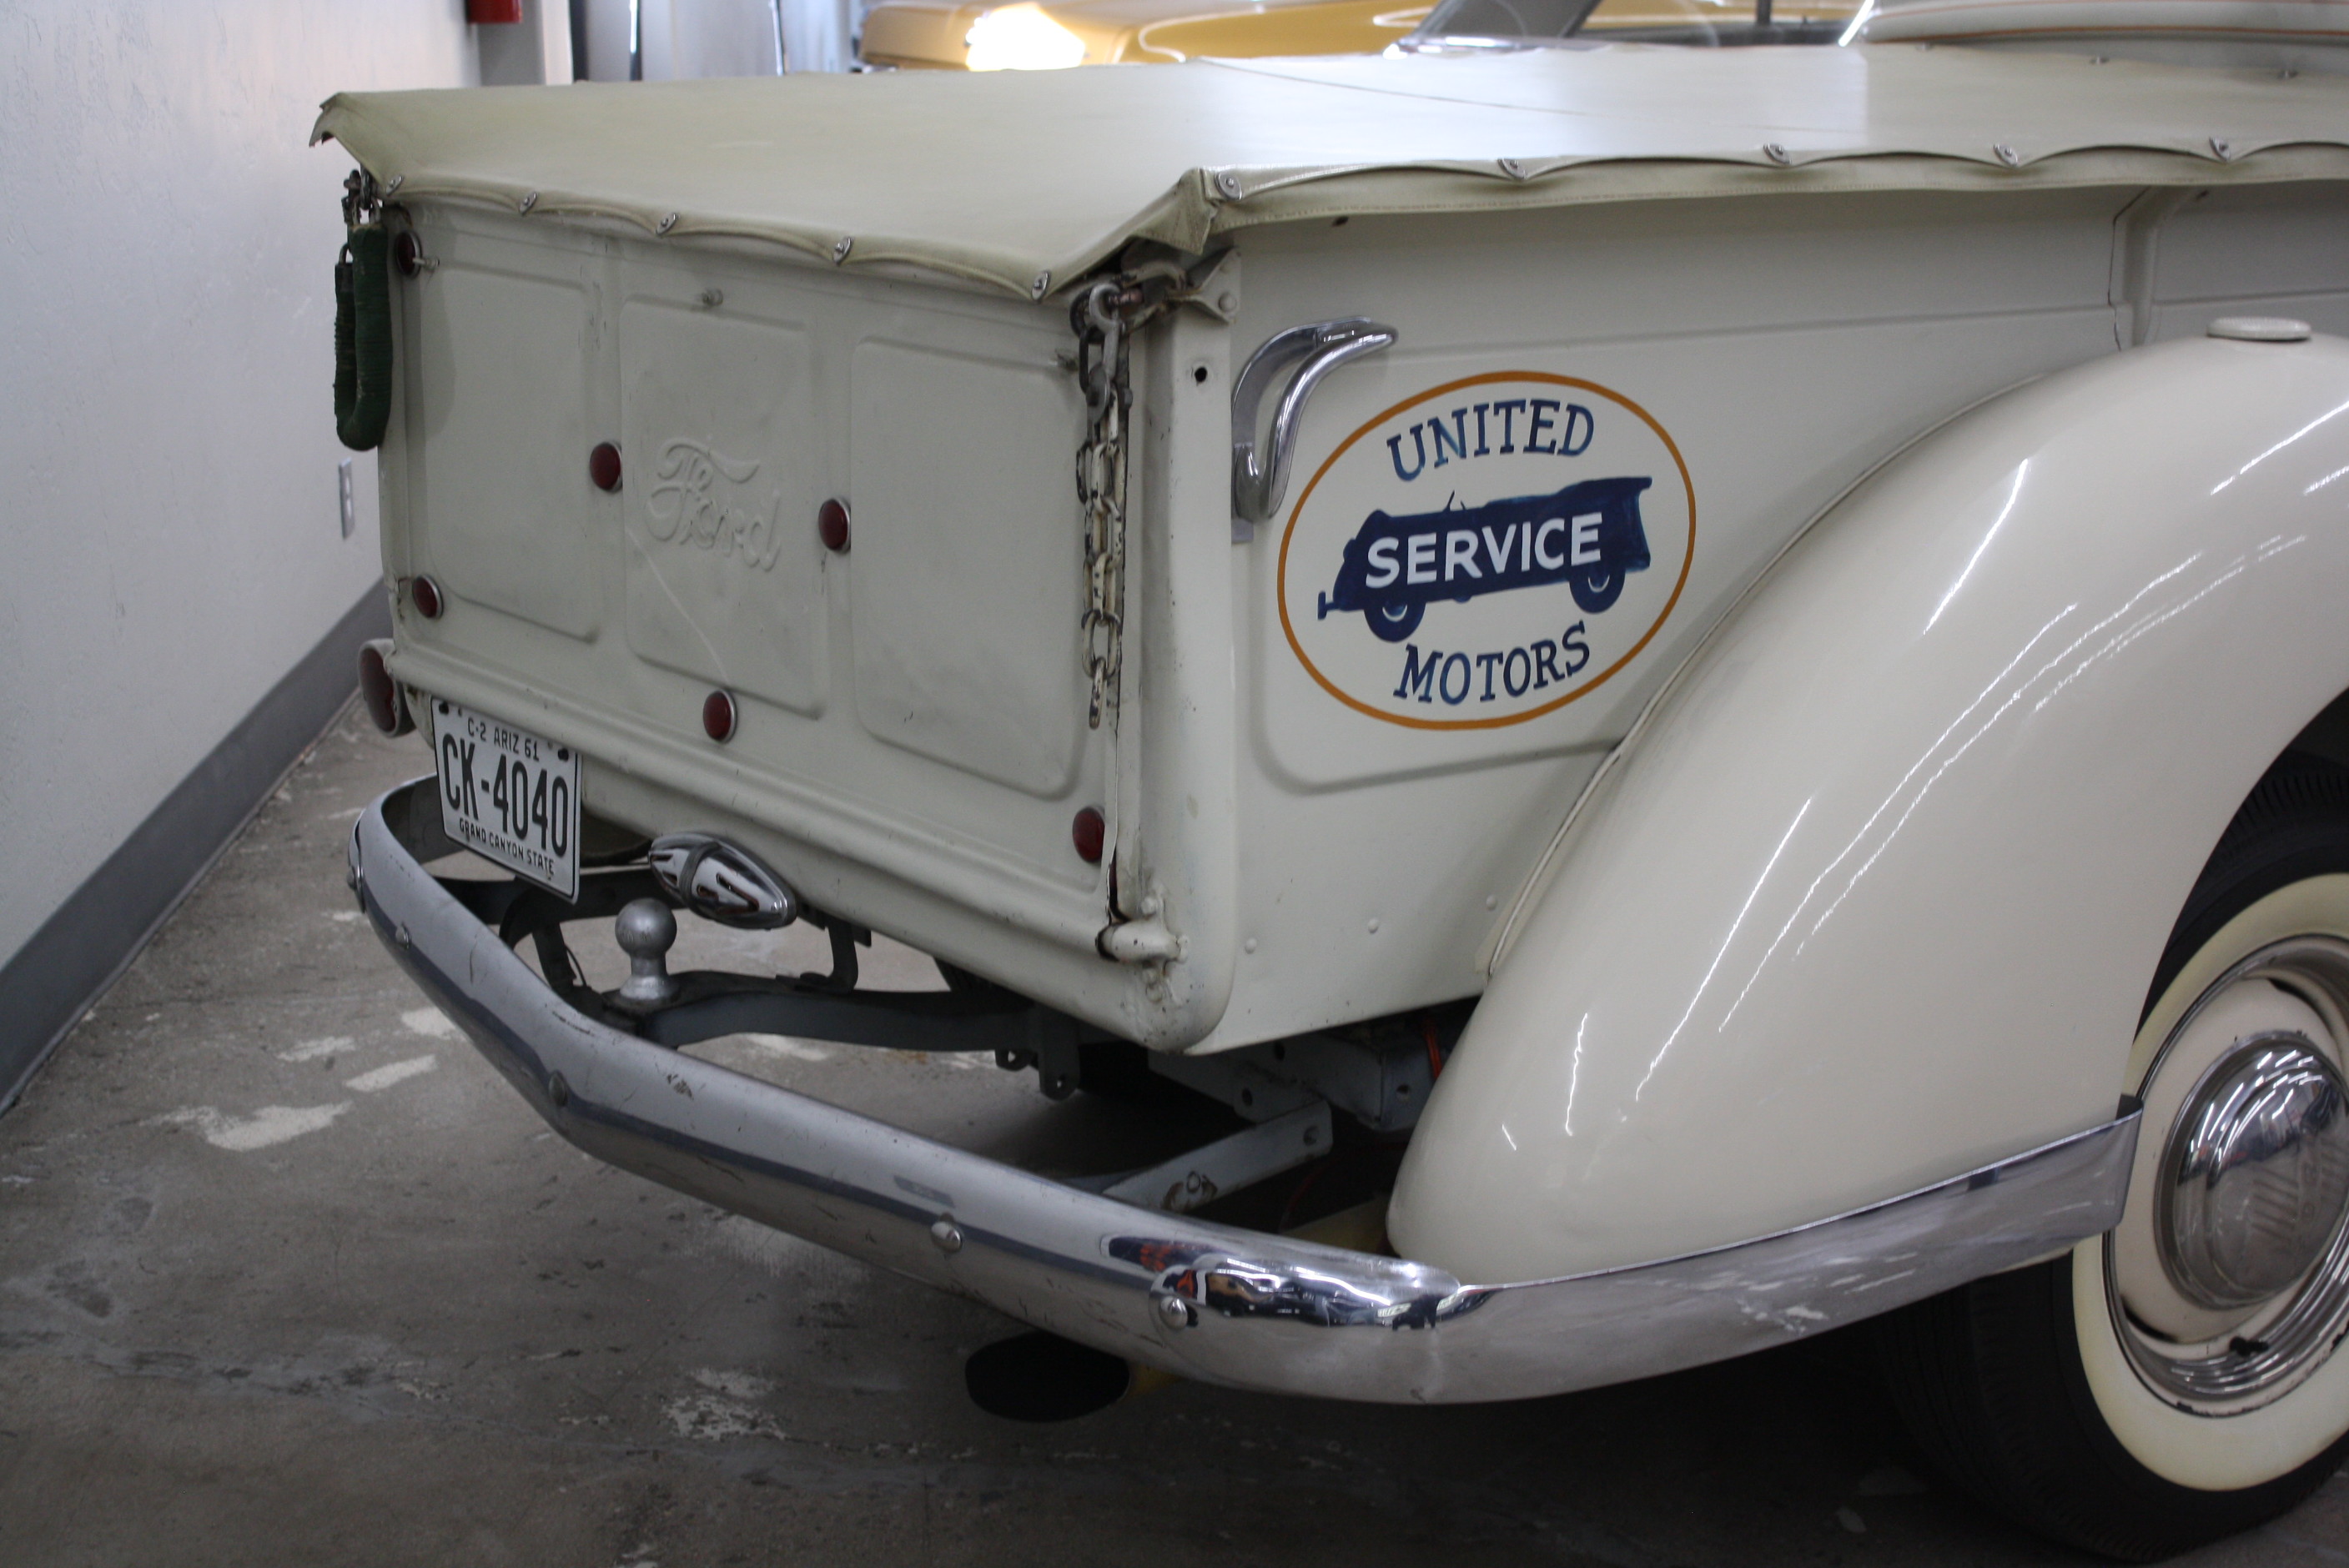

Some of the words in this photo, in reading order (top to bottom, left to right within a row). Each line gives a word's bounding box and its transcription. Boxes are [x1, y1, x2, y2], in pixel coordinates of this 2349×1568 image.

[1386, 399, 1594, 481] UNITED
[644, 438, 782, 573] Ford
[1366, 512, 1602, 588] SERVICE
[1393, 620, 1590, 705] MOTORS
[494, 727, 520, 754] ARIZ
[525, 741, 540, 761] 61
[442, 733, 568, 857] CK-4040
[459, 817, 486, 842] GRAND
[489, 832, 524, 859] CANYON
[526, 849, 554, 875] STATE
